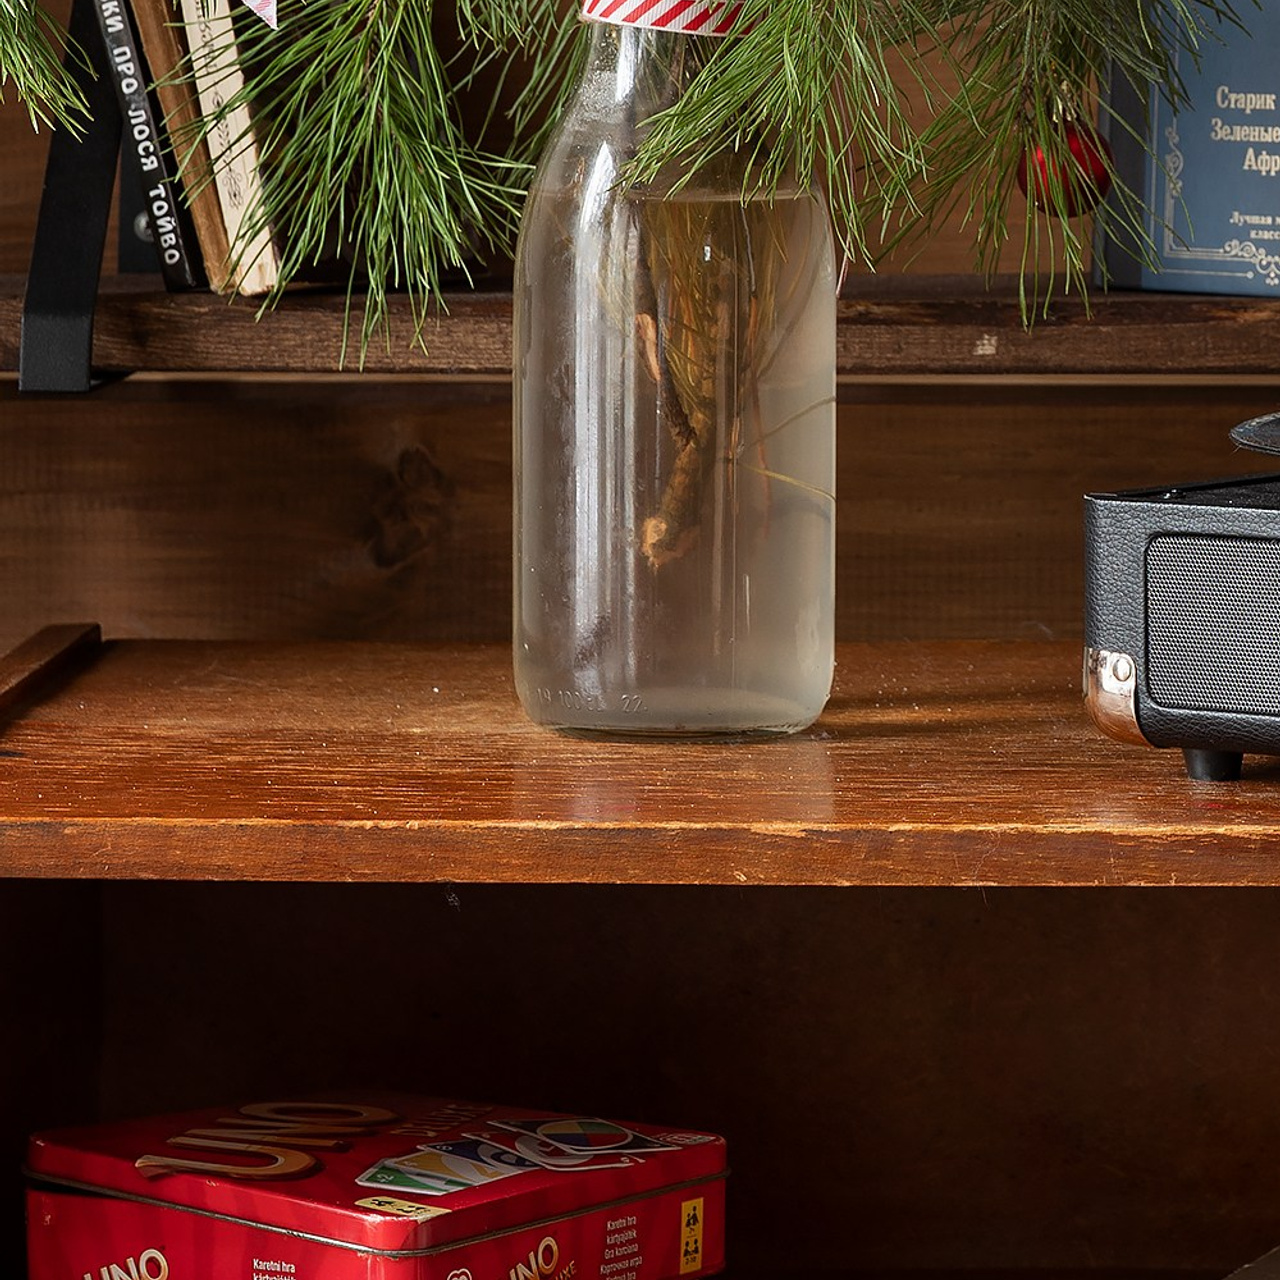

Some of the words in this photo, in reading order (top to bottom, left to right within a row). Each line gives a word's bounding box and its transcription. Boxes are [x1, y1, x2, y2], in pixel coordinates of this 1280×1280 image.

[1216, 85, 1277, 115] Старик
[112, 45, 139, 95] ПРО
[127, 109, 159, 172] ЛОСЯ
[149, 183, 181, 266] ТОЙВО
[1229, 211, 1273, 227] Лучшая
[134, 1101, 398, 1179] UNO
